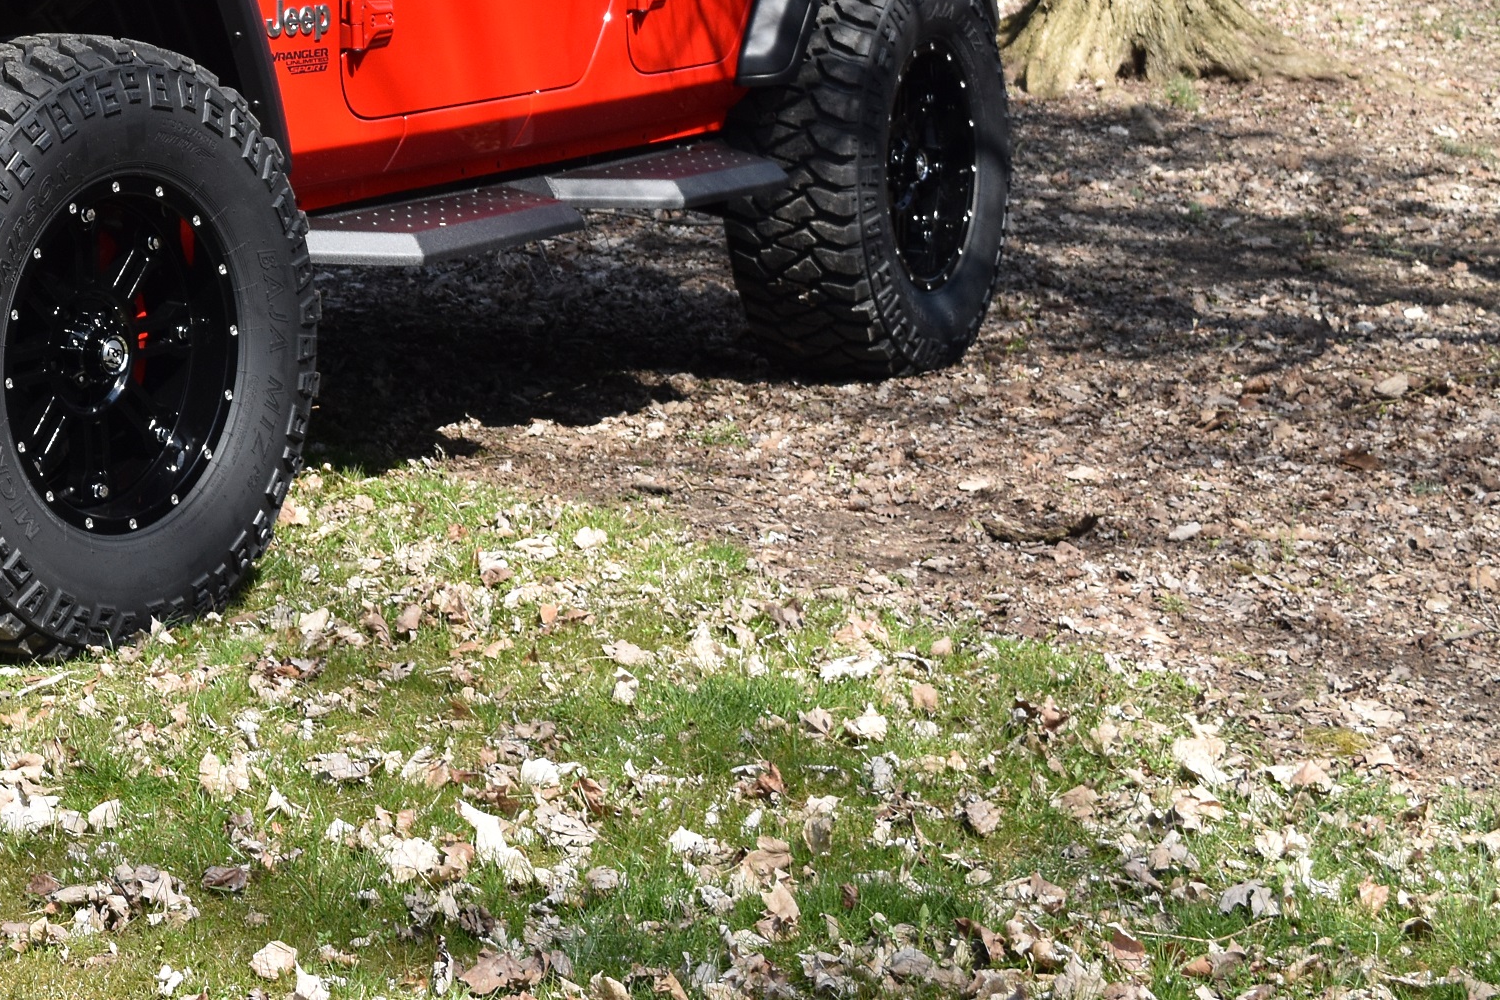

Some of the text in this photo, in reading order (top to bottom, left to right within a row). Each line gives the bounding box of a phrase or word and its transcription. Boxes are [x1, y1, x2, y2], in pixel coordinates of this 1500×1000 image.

[285, 57, 329, 66] UNLIMITED
[289, 64, 327, 75] SPORT
[256, 248, 290, 353] BAJA
[250, 374, 286, 466] MTZ
